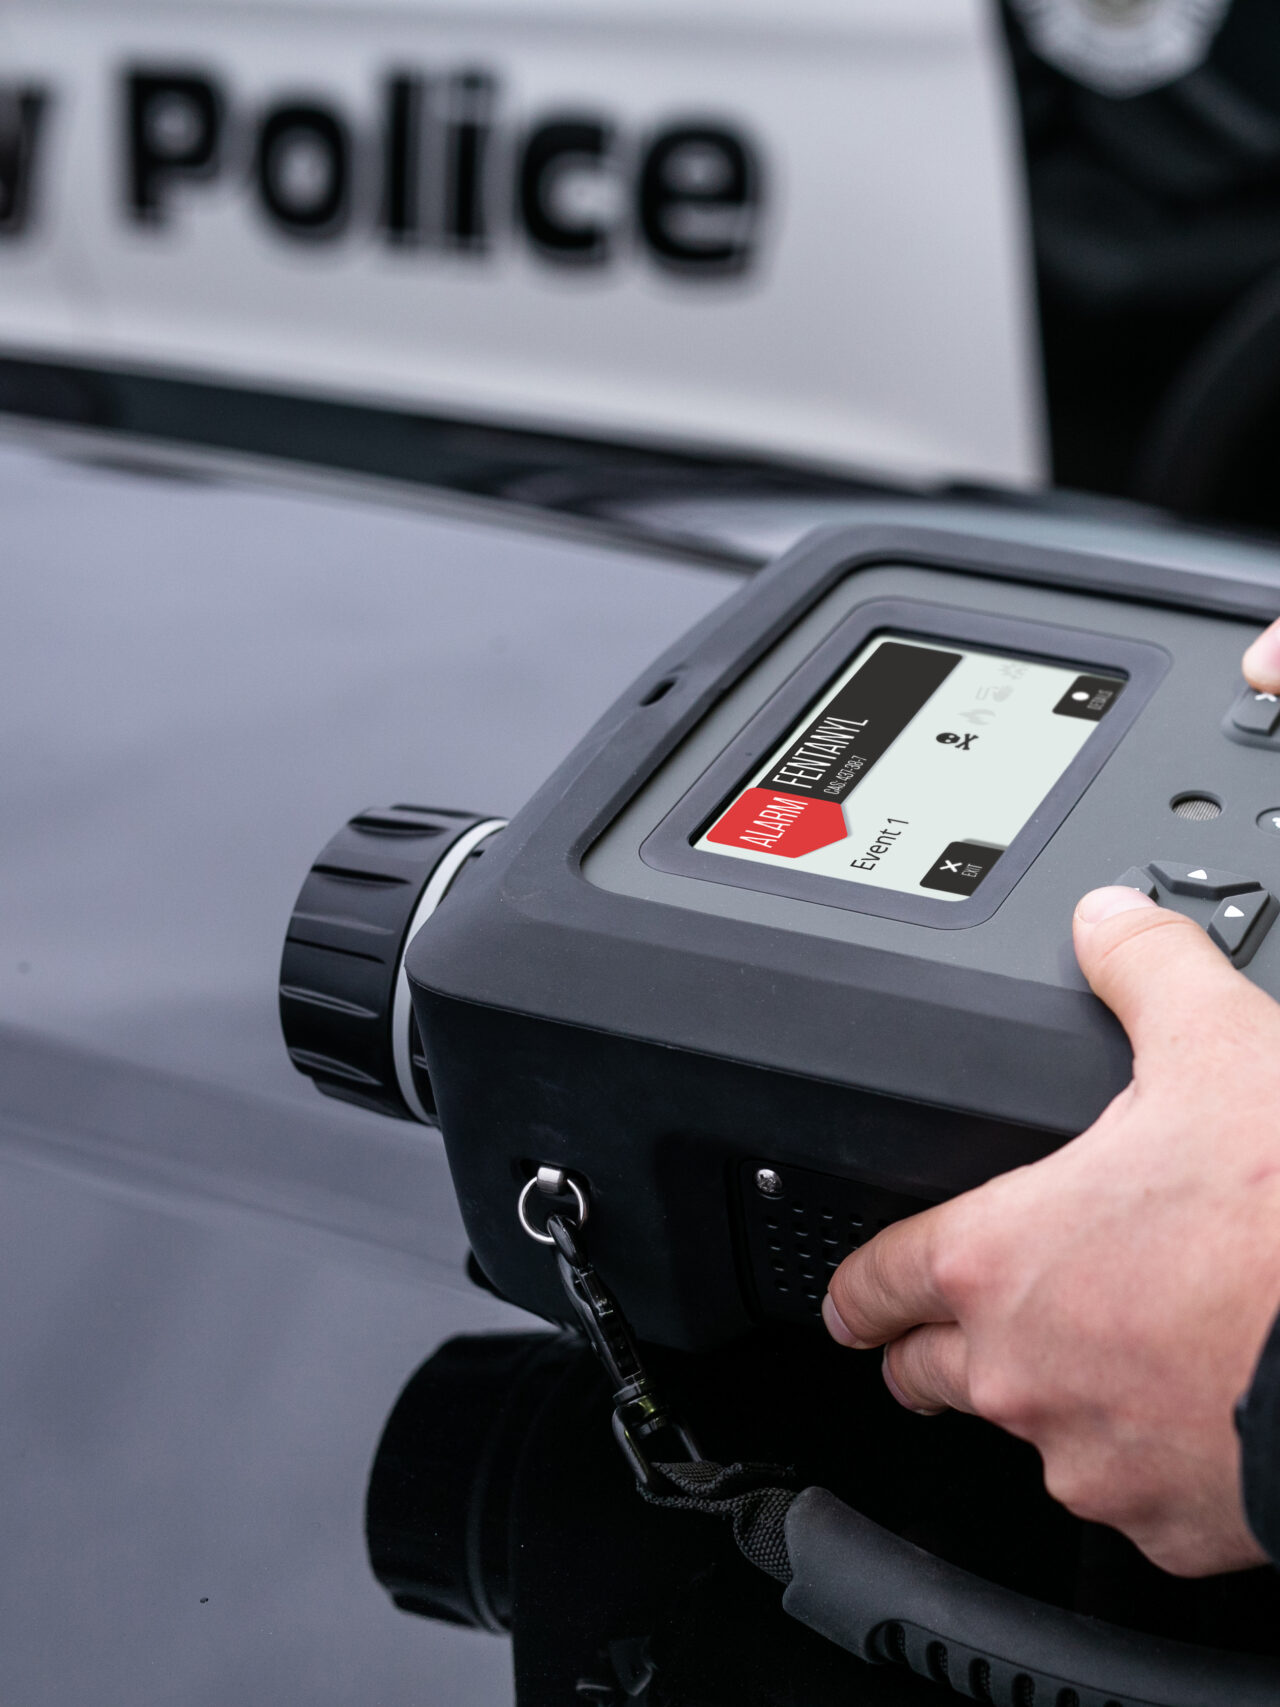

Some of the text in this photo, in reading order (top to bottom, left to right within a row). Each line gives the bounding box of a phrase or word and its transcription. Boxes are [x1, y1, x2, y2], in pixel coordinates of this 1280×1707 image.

[120, 62, 766, 282] Police
[772, 716, 869, 789] FENTANYL
[823, 755, 867, 795] CAS: 437-38-7
[739, 796, 808, 849] ALARM
[850, 828, 901, 871] Event
[961, 863, 983, 878] EXIT
